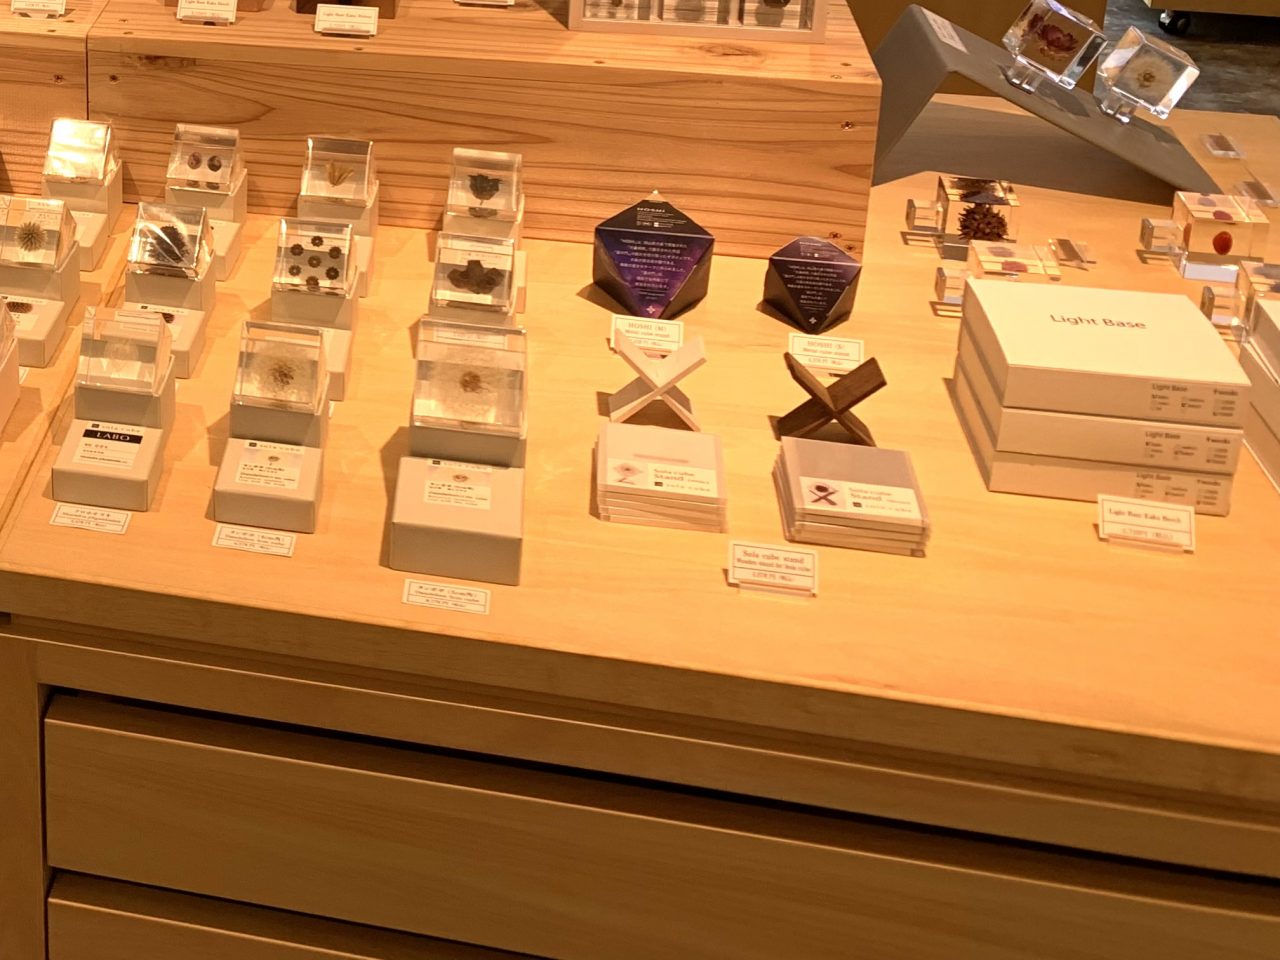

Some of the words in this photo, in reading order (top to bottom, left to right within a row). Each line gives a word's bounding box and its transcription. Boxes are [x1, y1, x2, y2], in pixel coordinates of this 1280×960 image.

[1050, 313, 1097, 327] Light
[1103, 318, 1147, 330] Base
[96, 432, 131, 441] LABO
[653, 473, 684, 482] Stand
[850, 492, 882, 502] Stand
[1109, 507, 1125, 517] Light
[1128, 510, 1141, 518] Base
[742, 550, 759, 559] Sola
[761, 553, 780, 561] cube
[783, 556, 805, 565] stand
